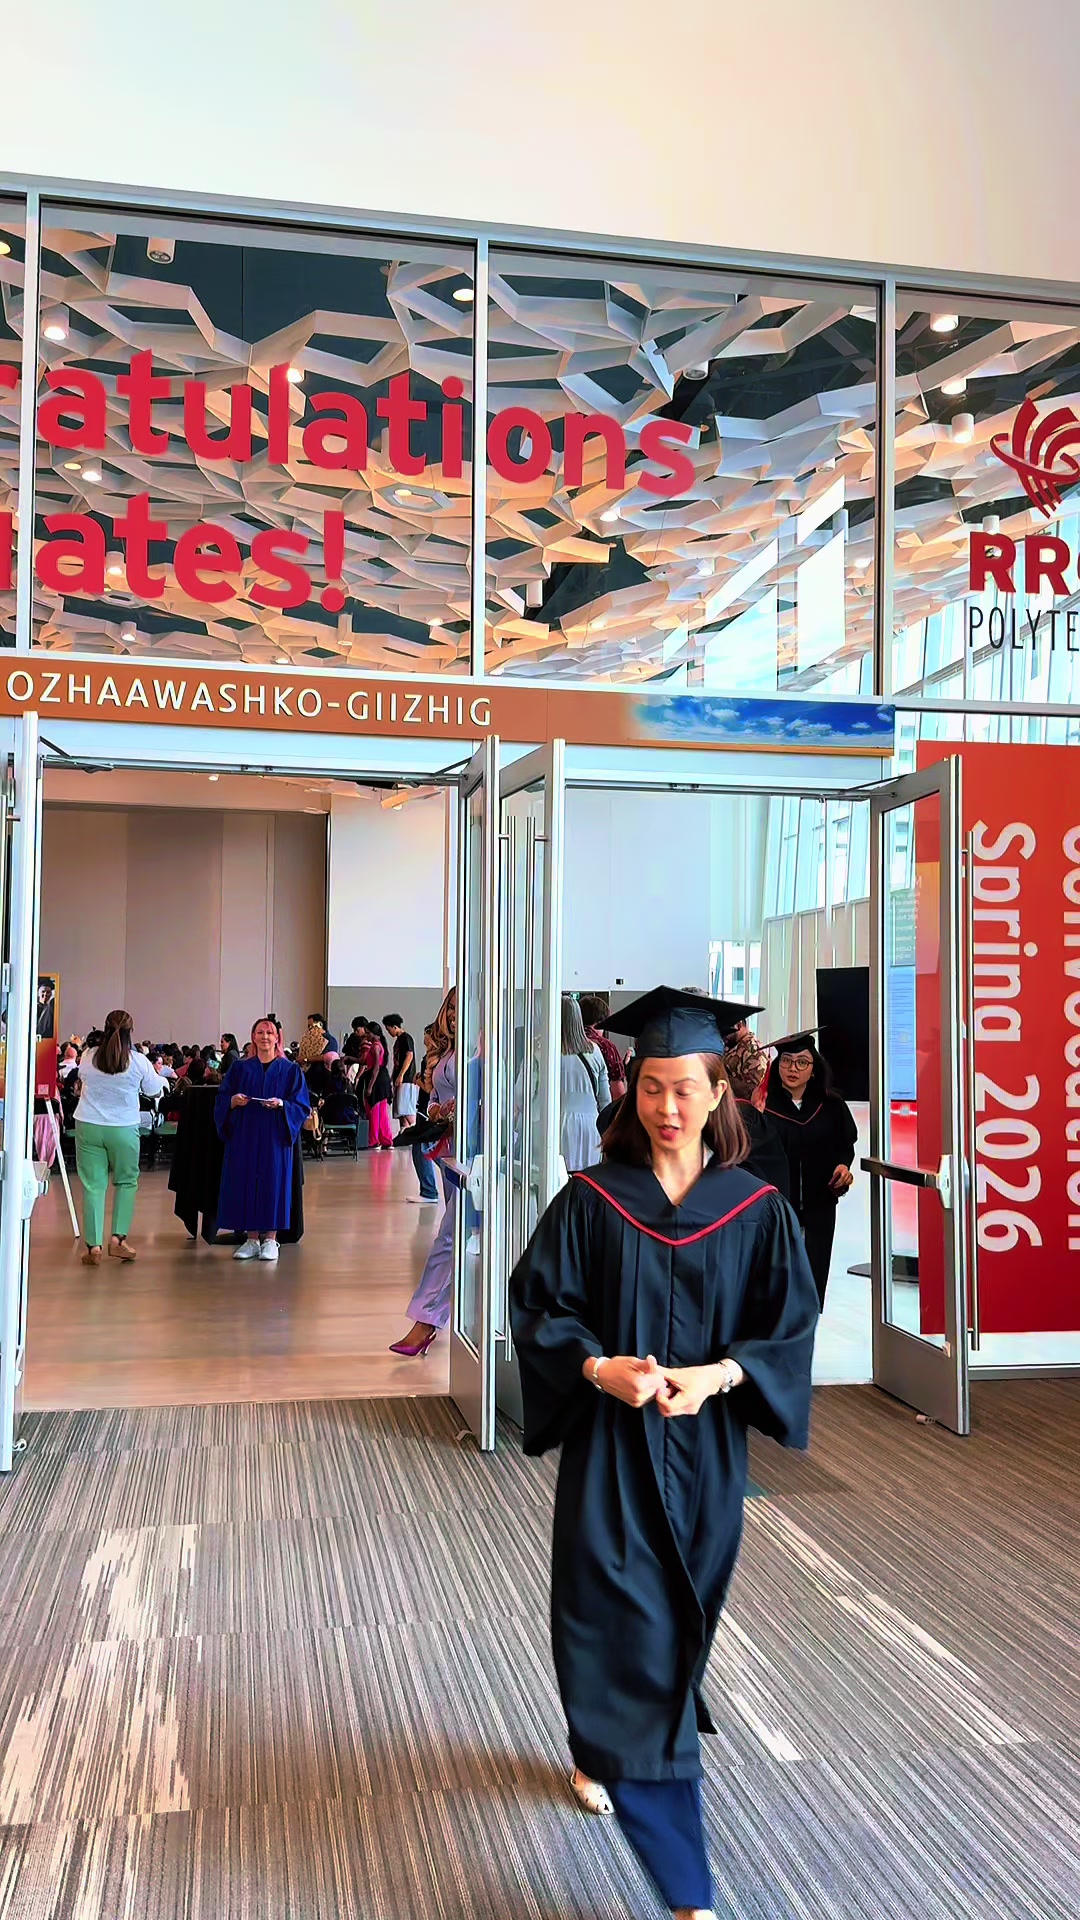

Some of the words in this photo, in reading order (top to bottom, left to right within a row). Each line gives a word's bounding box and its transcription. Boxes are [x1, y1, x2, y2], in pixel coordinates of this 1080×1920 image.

[0, 350, 696, 498] atulations
[0, 490, 346, 612] ates!
[969, 531, 1080, 596] RR
[6, 670, 492, 727] OZHAAWASHKO-GIIZHIG
[975, 1071, 1043, 1252] 2026
